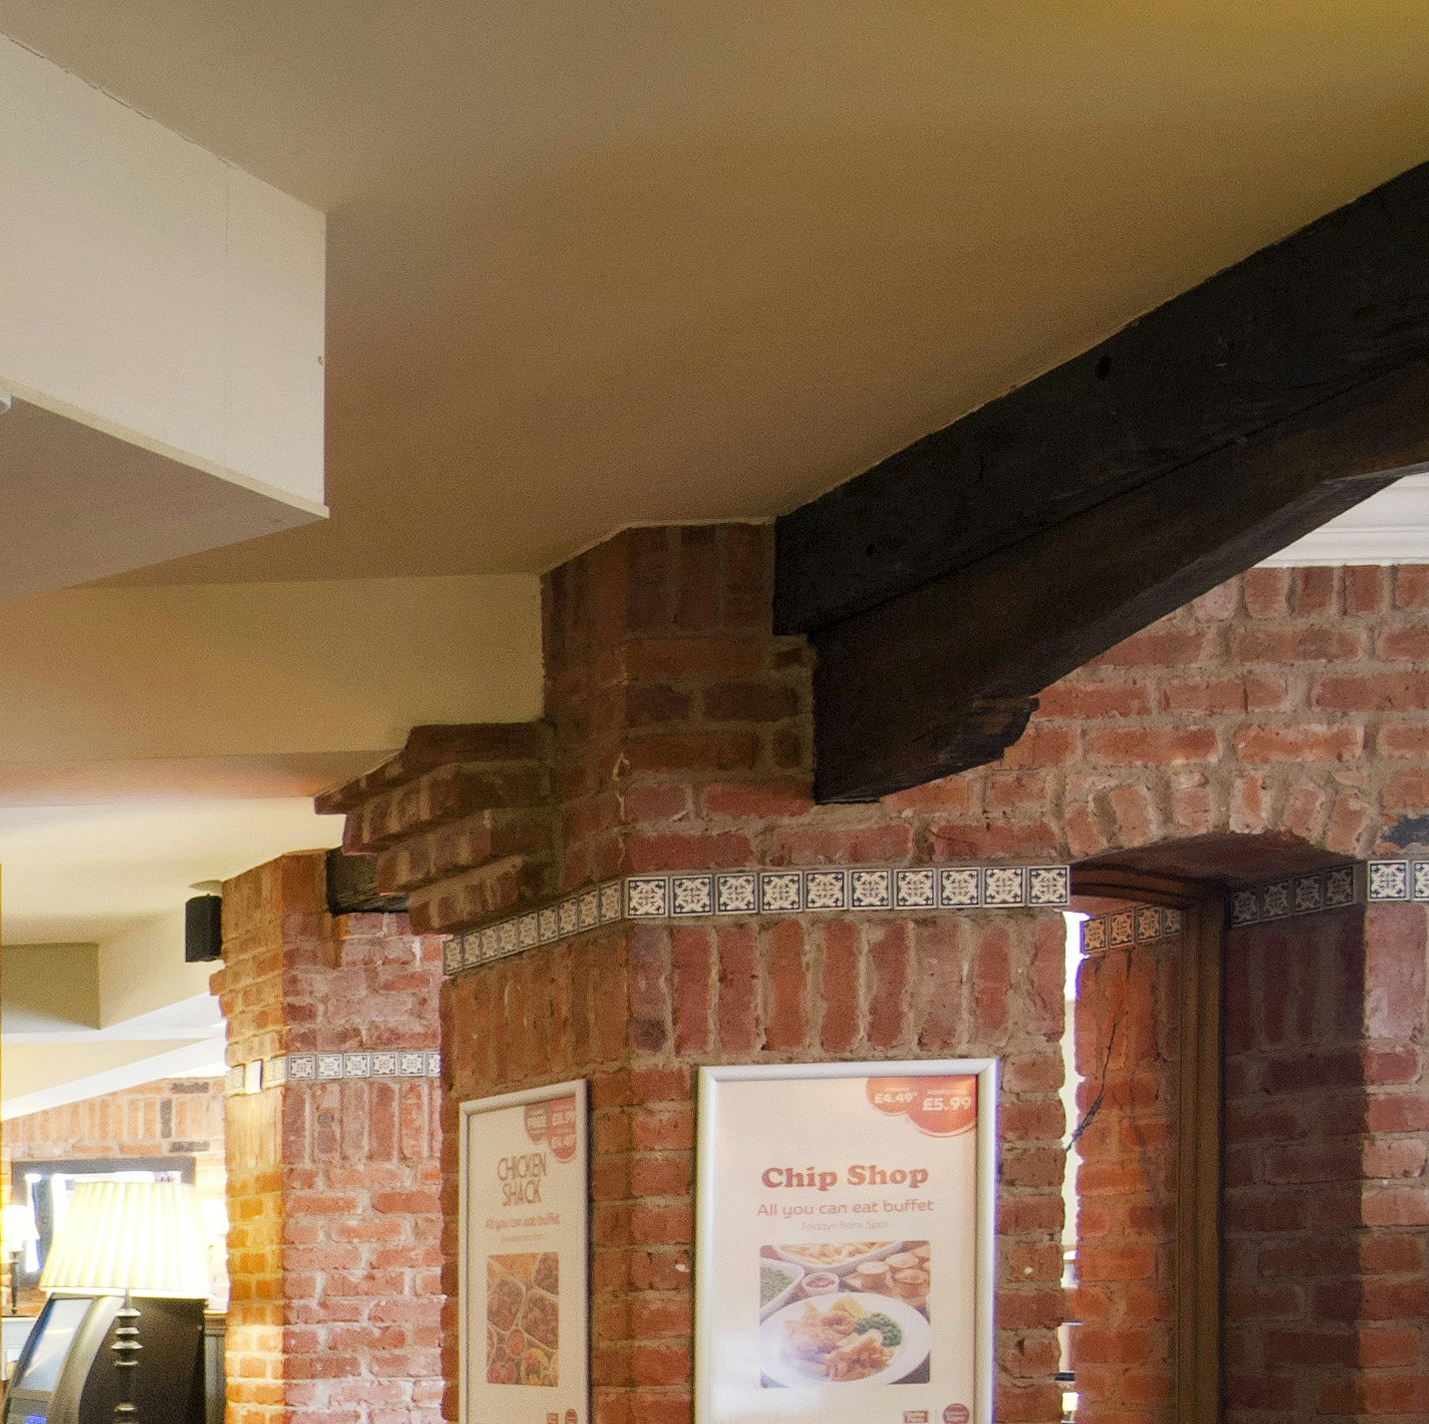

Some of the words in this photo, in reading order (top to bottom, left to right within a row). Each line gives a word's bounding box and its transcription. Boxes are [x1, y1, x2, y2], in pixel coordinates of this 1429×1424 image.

[922, 1096, 972, 1112] £5.99
[761, 1166, 838, 1192] Chip
[846, 1164, 929, 1189] Shop
[757, 1203, 777, 1217] All
[782, 1204, 814, 1219] you
[818, 1203, 847, 1216] can
[852, 1201, 879, 1214] eat
[883, 1199, 934, 1213] buffet
